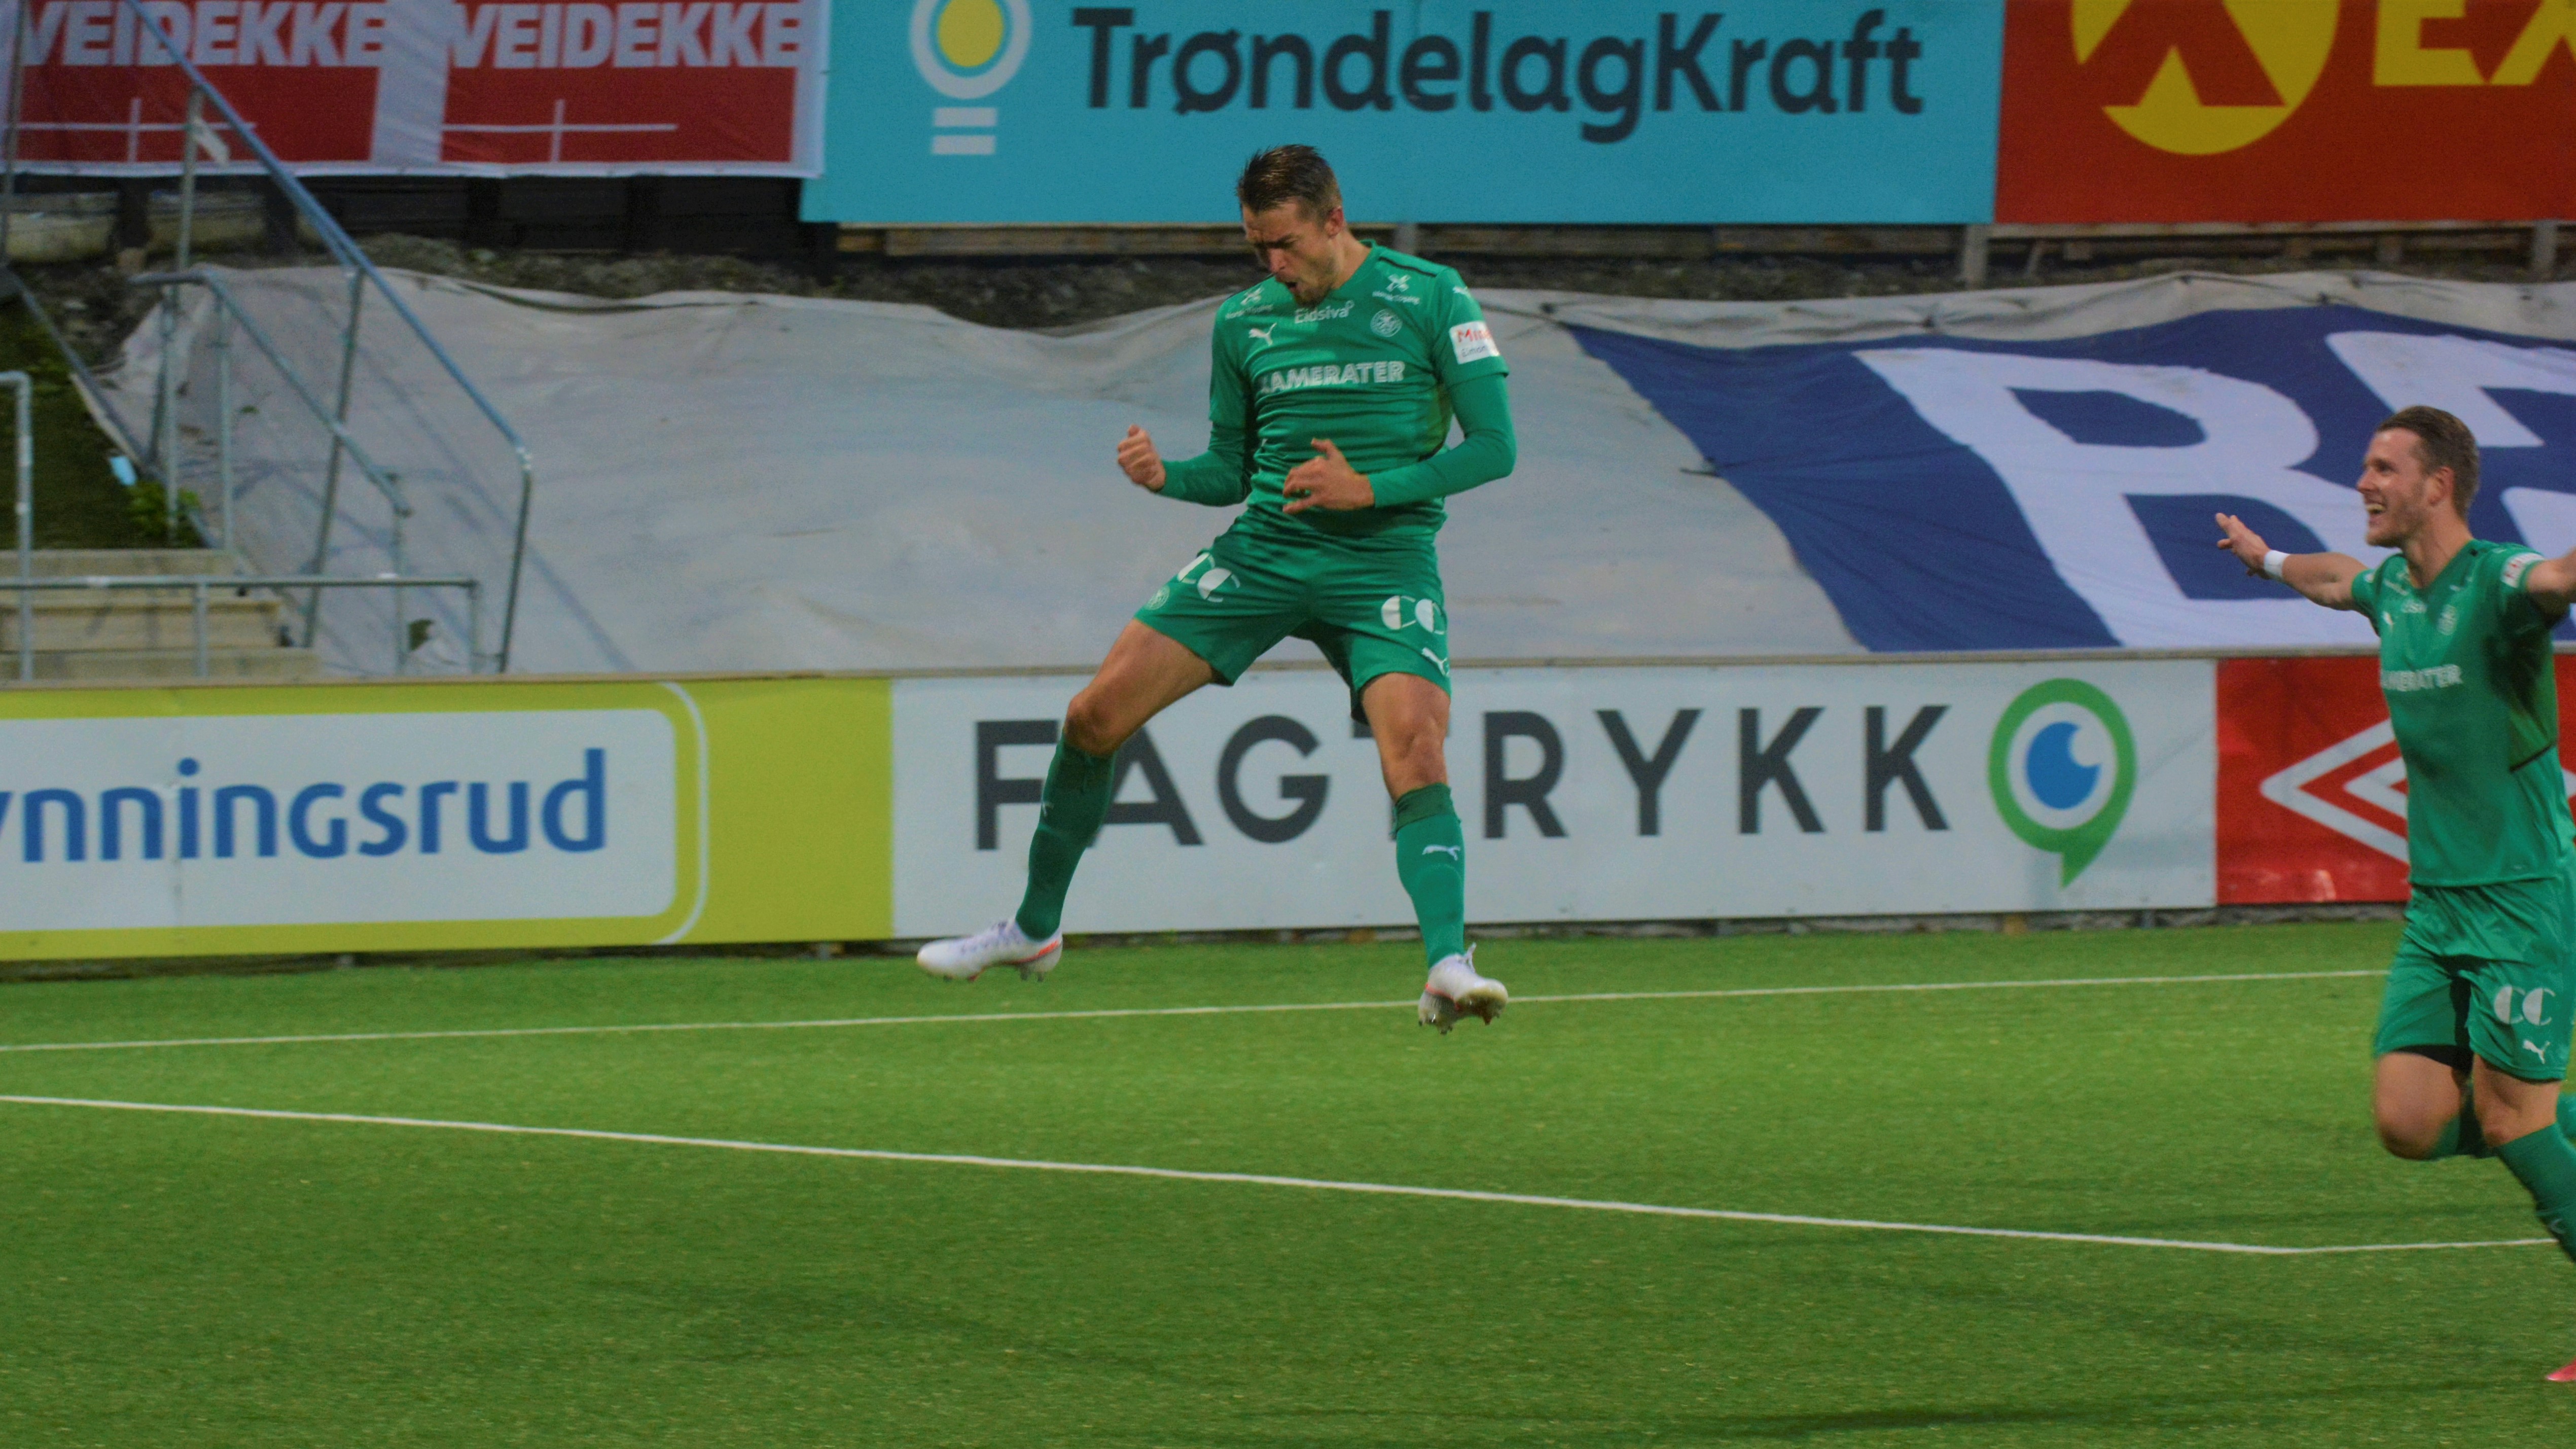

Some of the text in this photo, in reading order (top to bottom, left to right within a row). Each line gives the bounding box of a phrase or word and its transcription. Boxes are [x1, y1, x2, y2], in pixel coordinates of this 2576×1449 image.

[22, 0, 387, 66] VEIDEKKE
[440, 2, 802, 68] VEIDEKKE
[1071, 7, 1923, 145] TrøndelagKraft
[0, 748, 606, 863] nningsrud
[975, 705, 1952, 851] FAGRYKK
